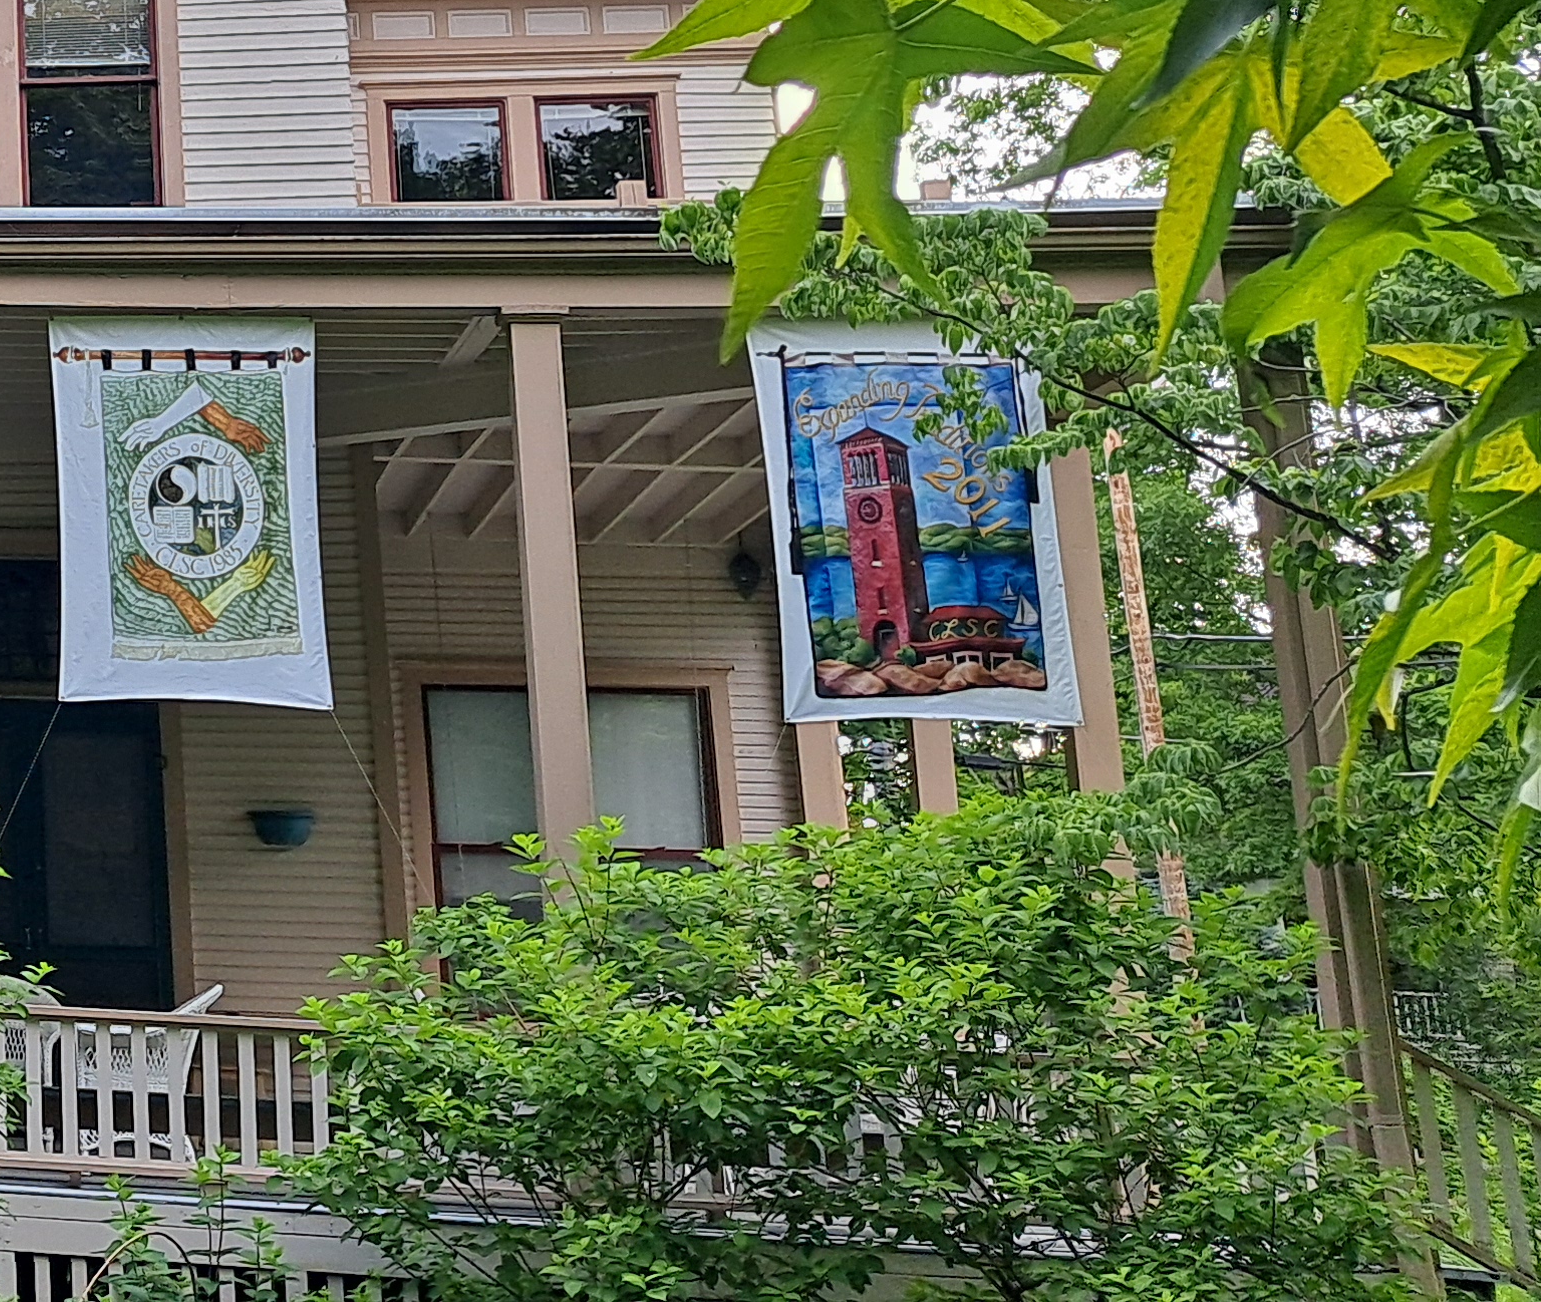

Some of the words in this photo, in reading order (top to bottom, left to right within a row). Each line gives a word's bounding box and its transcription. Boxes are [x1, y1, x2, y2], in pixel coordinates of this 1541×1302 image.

[131, 442, 181, 537] CARETAKERS
[214, 444, 262, 530] DIVERSITY
[922, 457, 1012, 538] 2011
[155, 547, 205, 575] CLSC
[208, 541, 244, 574] 1985
[929, 618, 998, 642] CLSC
